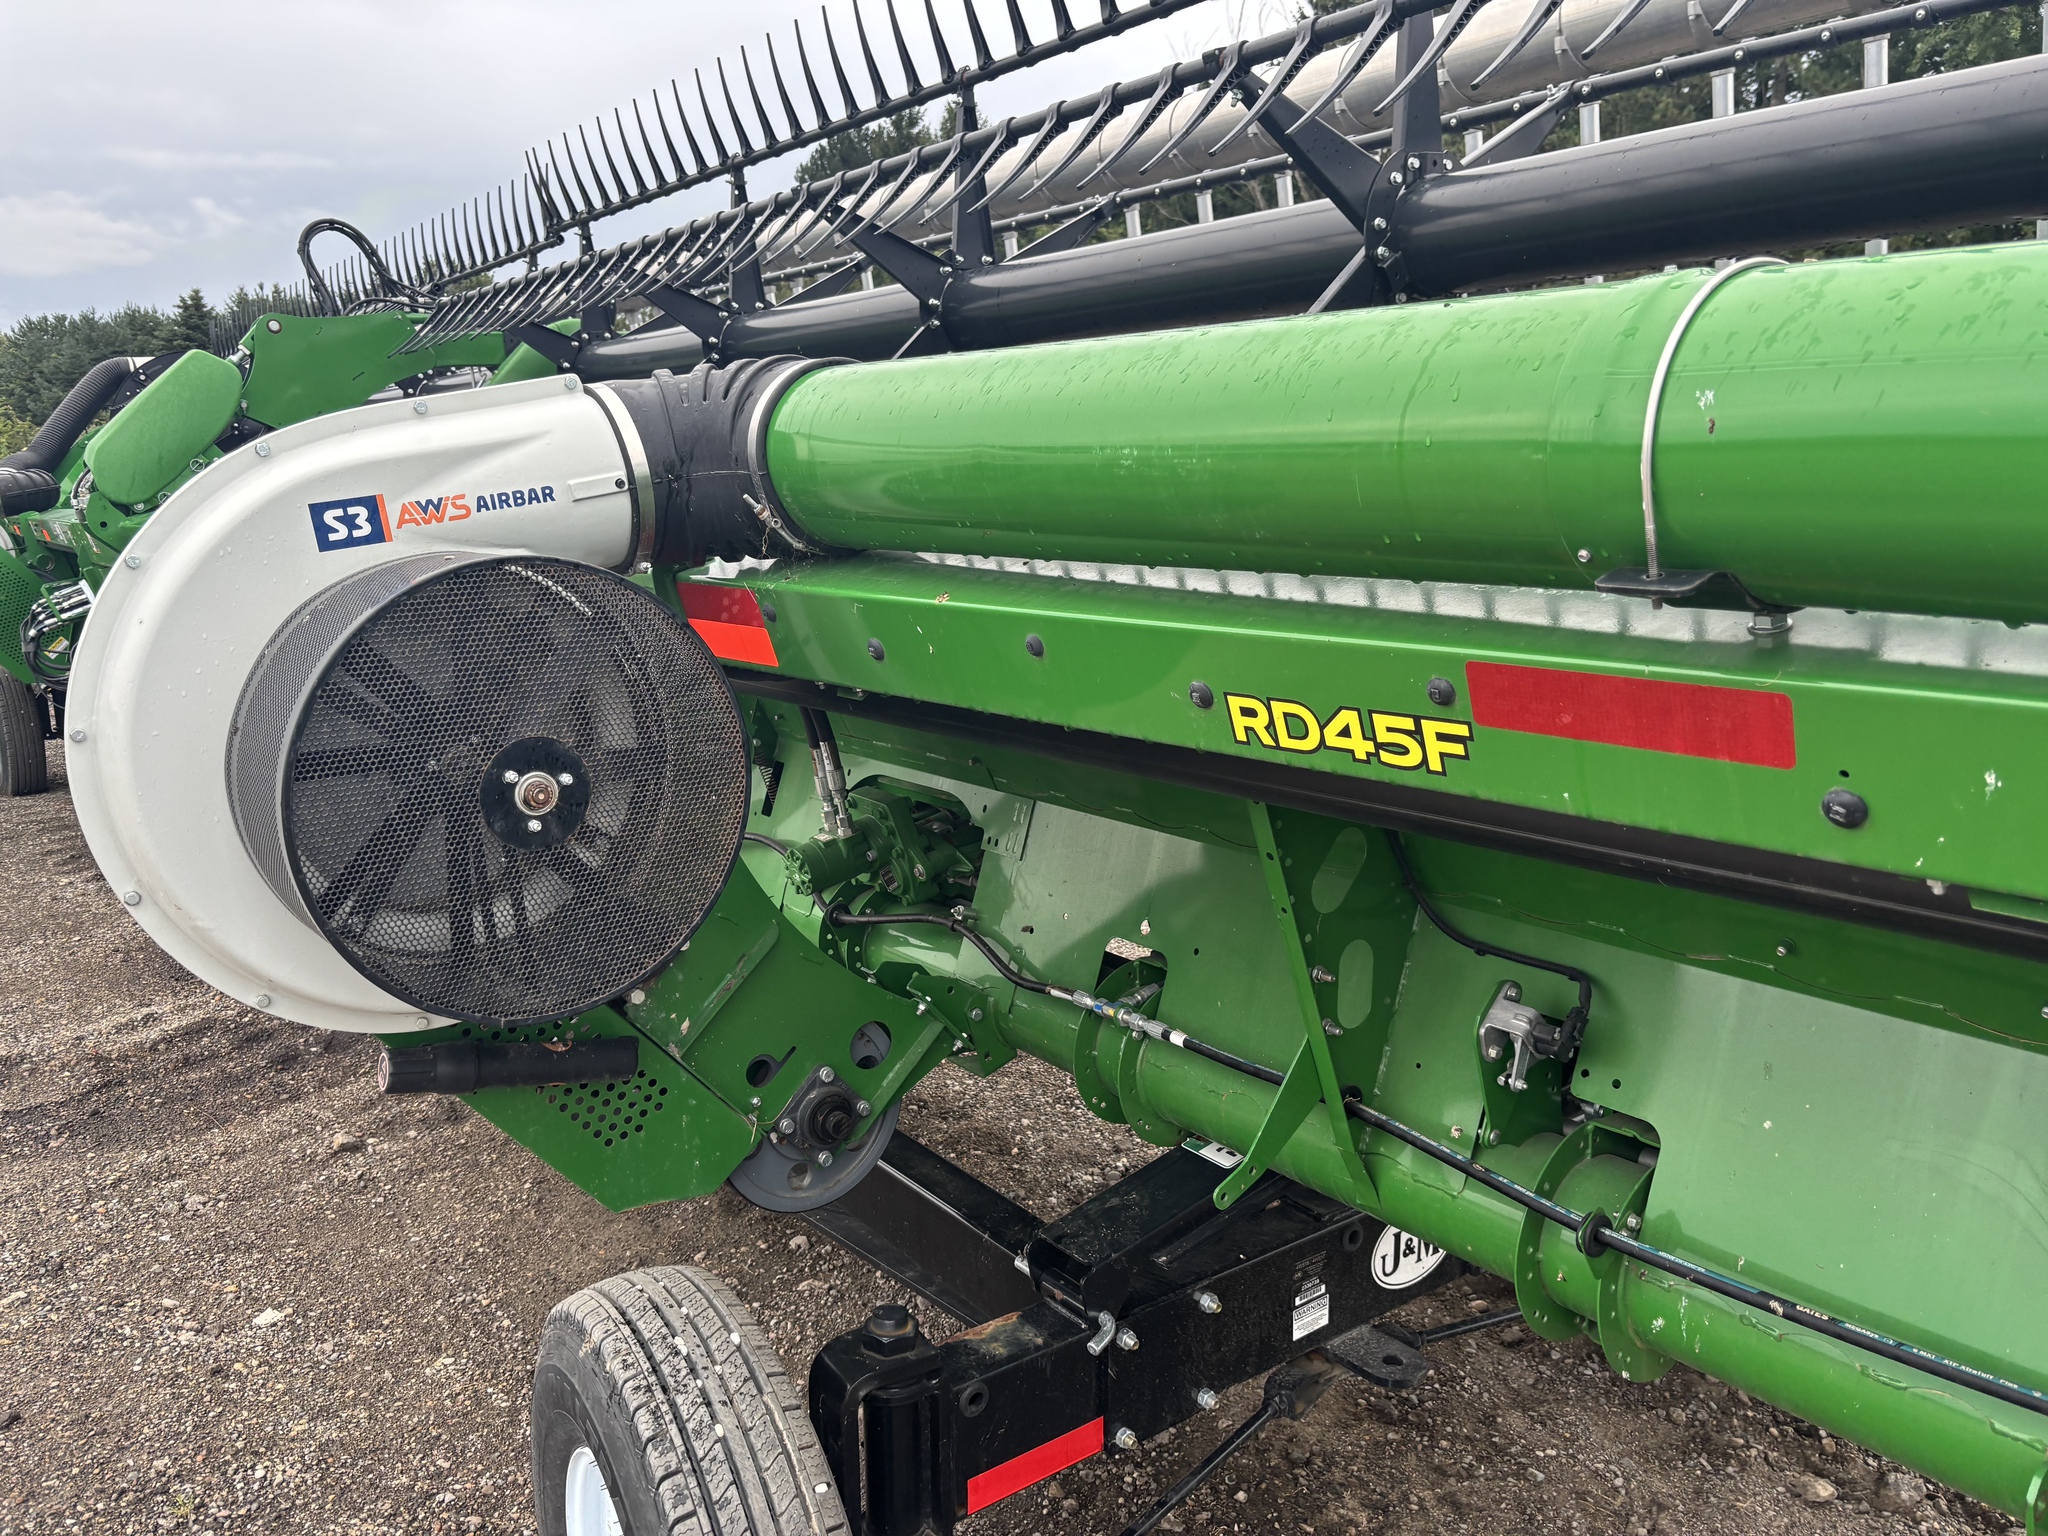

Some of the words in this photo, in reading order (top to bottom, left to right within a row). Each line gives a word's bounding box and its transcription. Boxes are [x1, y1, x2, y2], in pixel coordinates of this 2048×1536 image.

[322, 504, 373, 542] S3
[476, 485, 557, 513] AIRBAR
[1224, 692, 1474, 776] RD45F
[1294, 1297, 1327, 1320] WARNING
[1795, 1304, 1829, 1321] GATES
